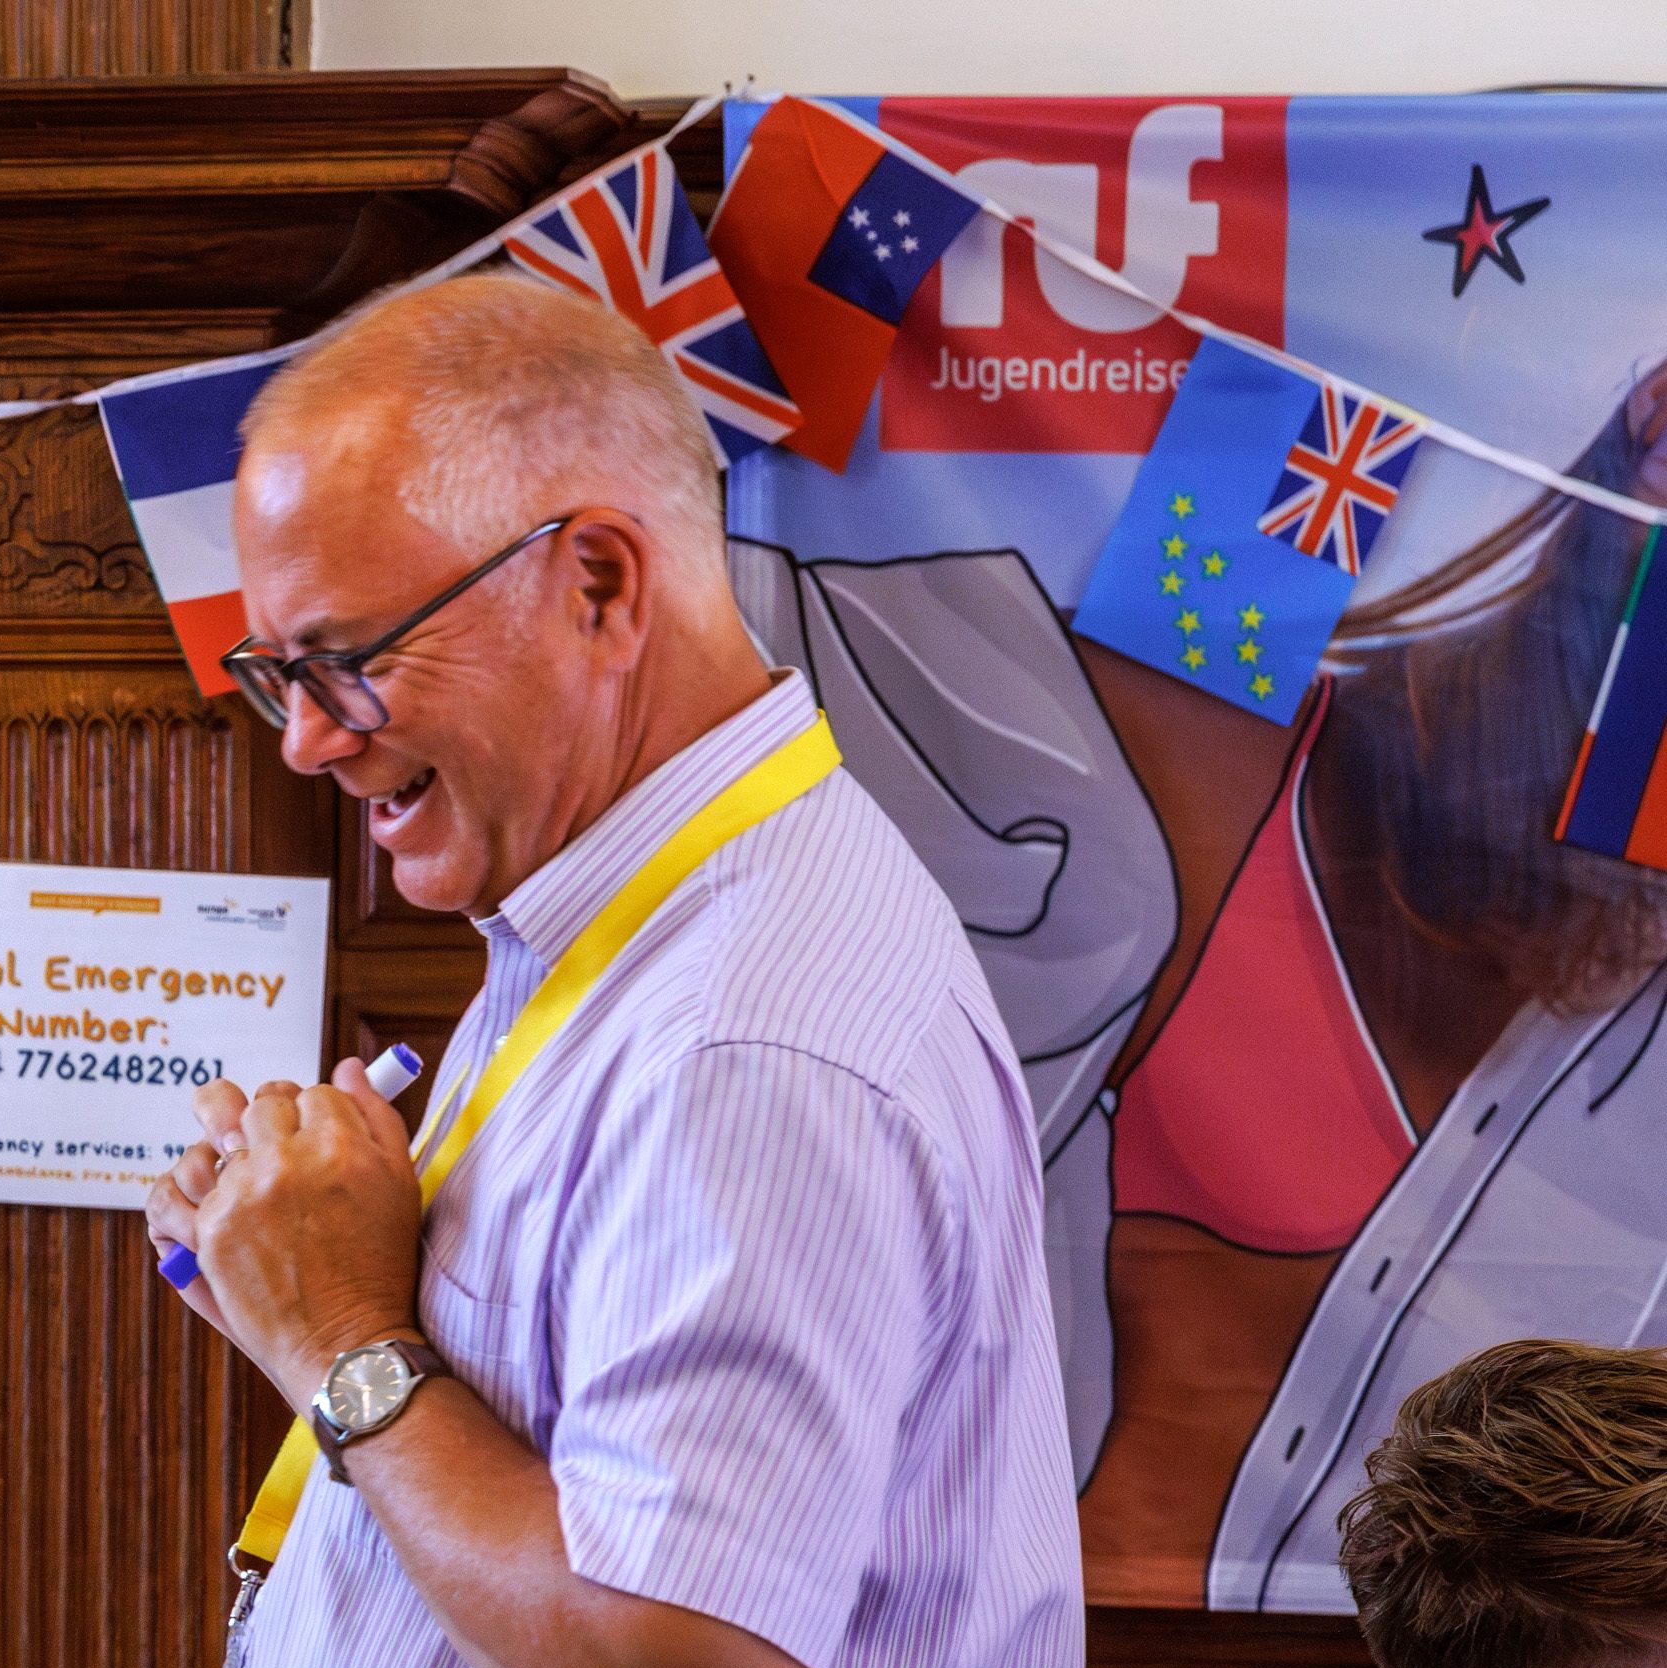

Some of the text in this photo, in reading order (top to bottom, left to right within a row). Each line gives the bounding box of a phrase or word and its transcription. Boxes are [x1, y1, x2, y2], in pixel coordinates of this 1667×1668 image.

[940, 103, 1224, 333] ruf
[45, 956, 285, 1008] Emergency
[17, 1049, 224, 1087] 7762482961
[54, 1138, 152, 1161] services:
